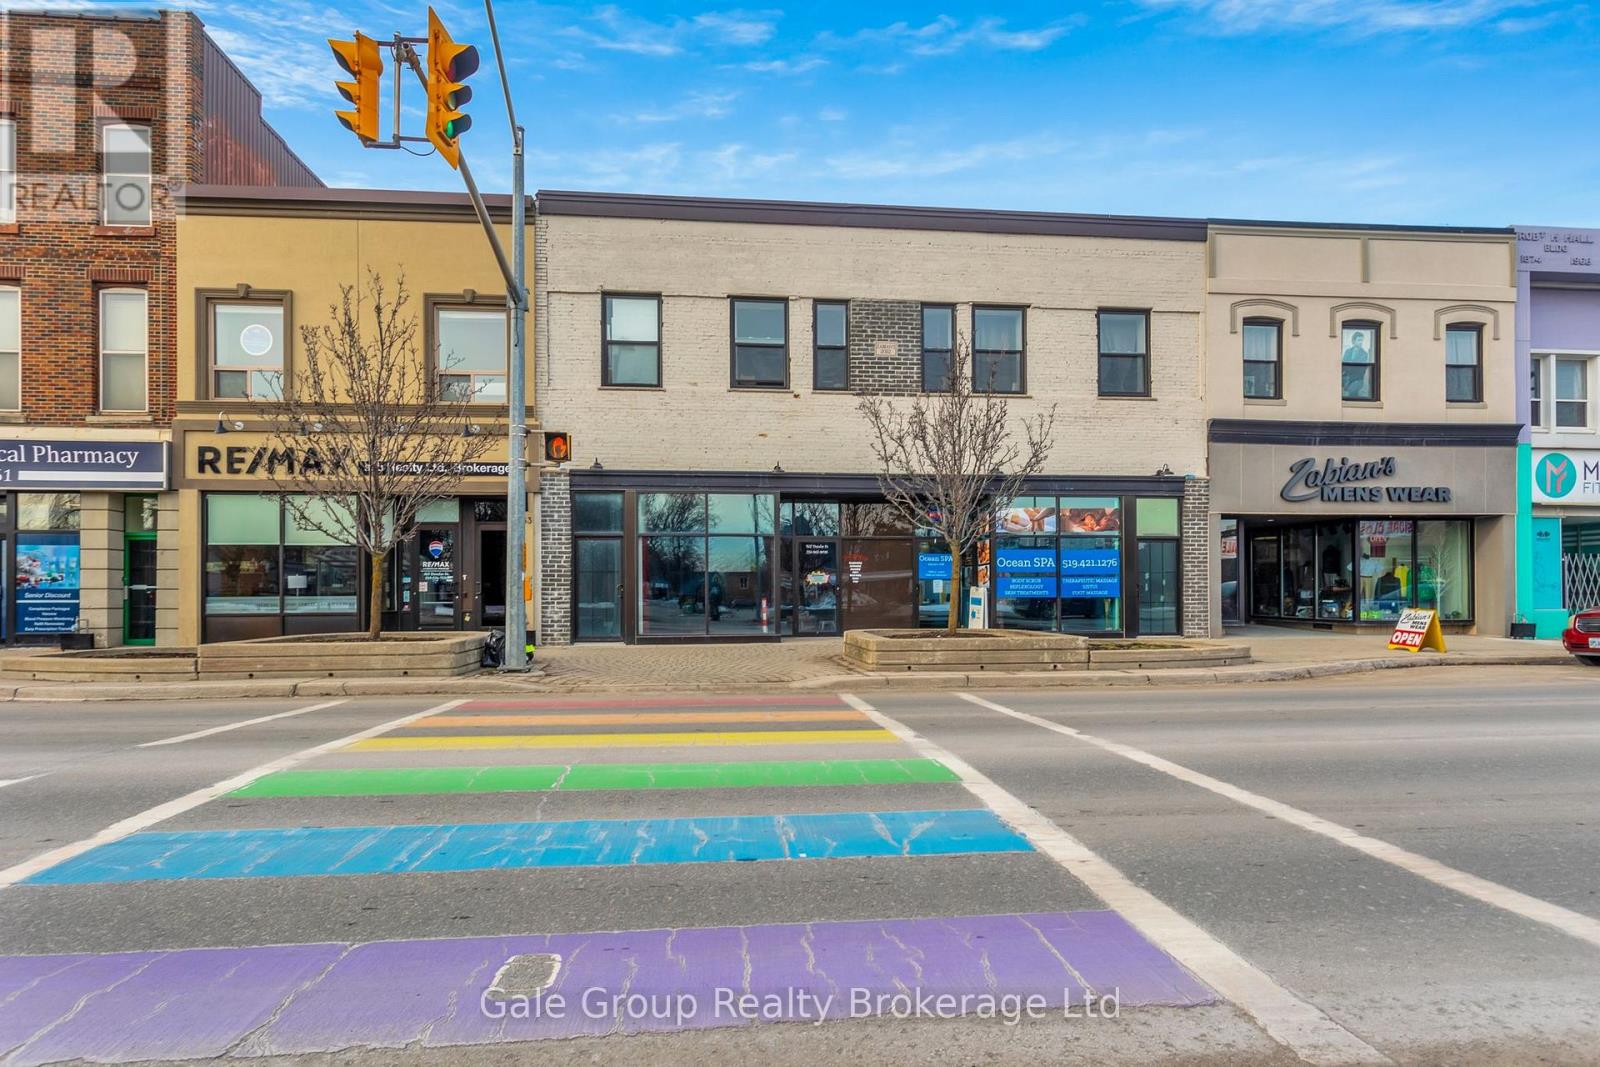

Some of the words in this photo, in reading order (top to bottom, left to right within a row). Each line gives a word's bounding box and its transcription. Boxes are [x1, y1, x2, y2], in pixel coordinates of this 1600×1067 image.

[32, 445, 139, 468] Pharmacy
[198, 446, 350, 475] RE/MAX
[1320, 486, 1383, 503] MENS
[1387, 486, 1451, 503] WEAR
[997, 557, 1031, 568] Ocean
[1033, 557, 1056, 568] SPA
[1062, 557, 1118, 569] 519.421.1276
[1391, 631, 1423, 646] OPEN
